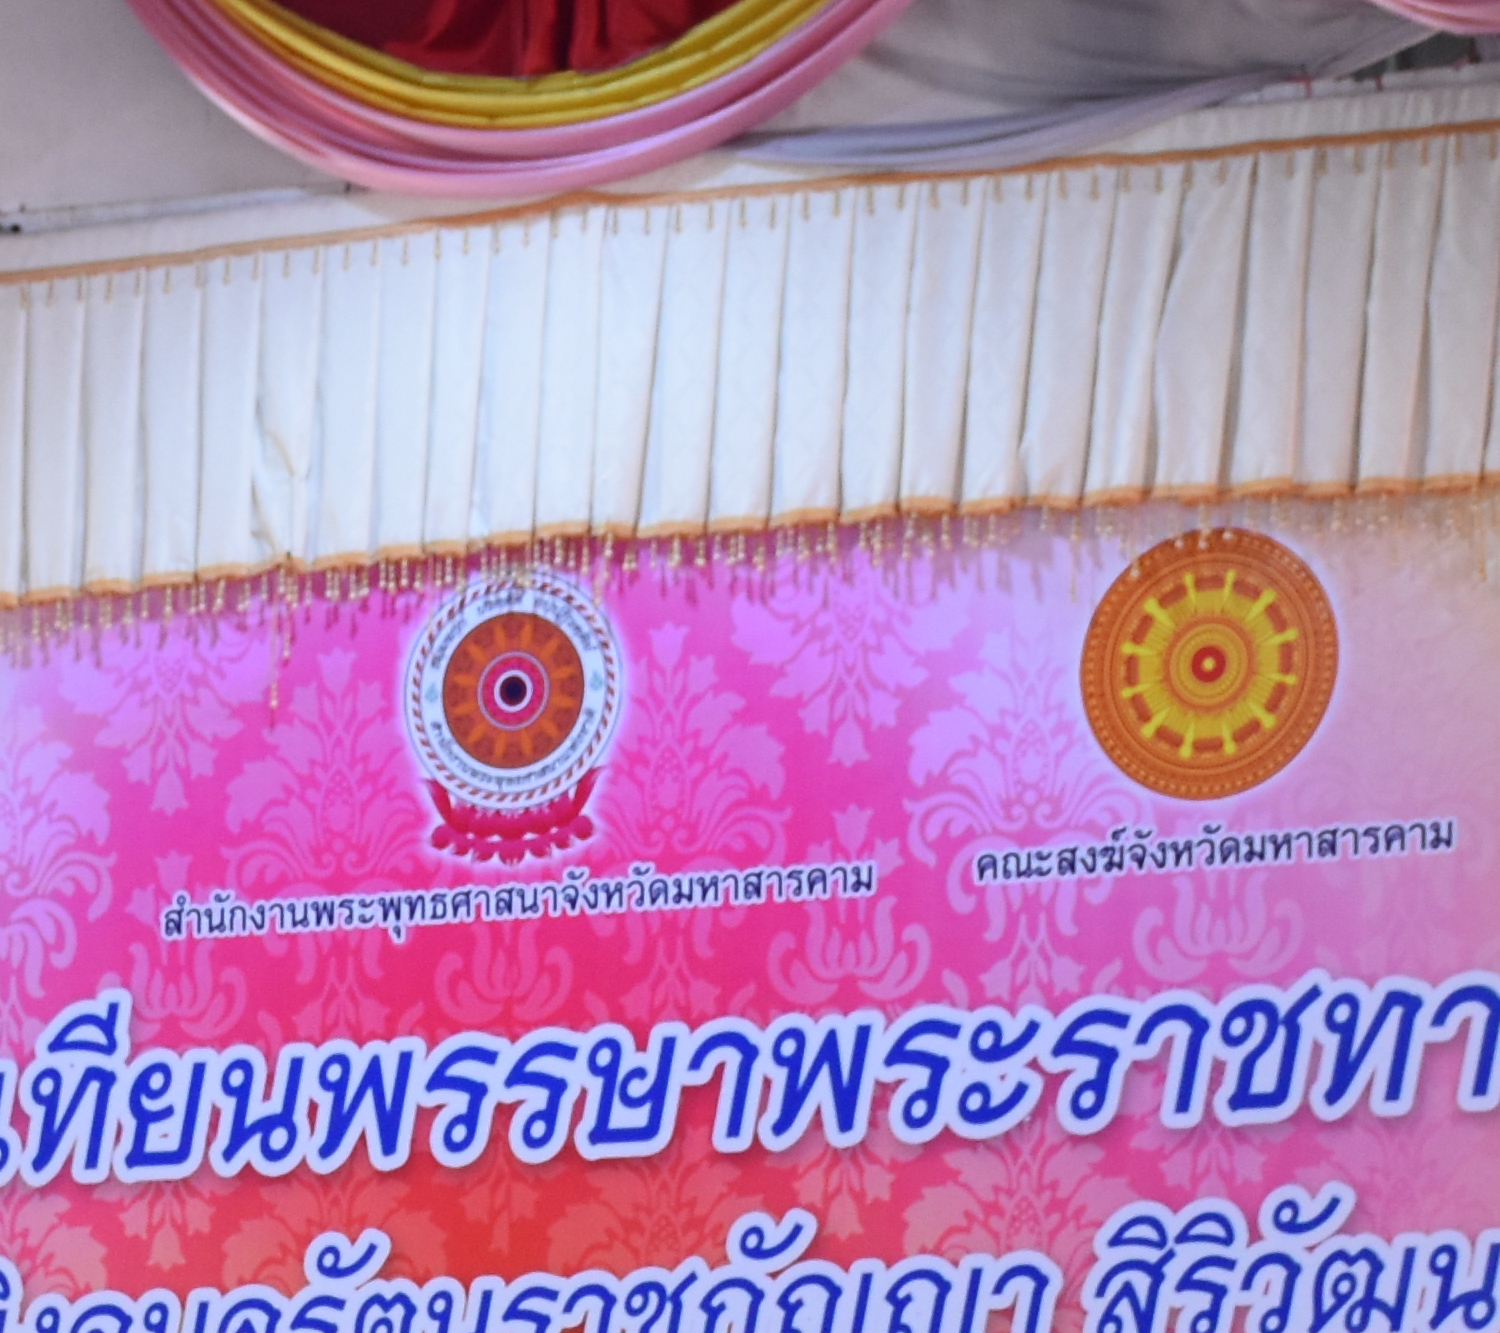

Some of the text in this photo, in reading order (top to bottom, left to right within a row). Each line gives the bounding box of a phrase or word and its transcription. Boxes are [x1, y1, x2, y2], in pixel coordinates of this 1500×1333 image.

[976, 821, 1454, 881] คณะสงฆ์จังหวัดมหาสารคาม
[164, 865, 873, 938] สำนักงานพระพุทธศาสนาจังหวัดมหาสารคาม
